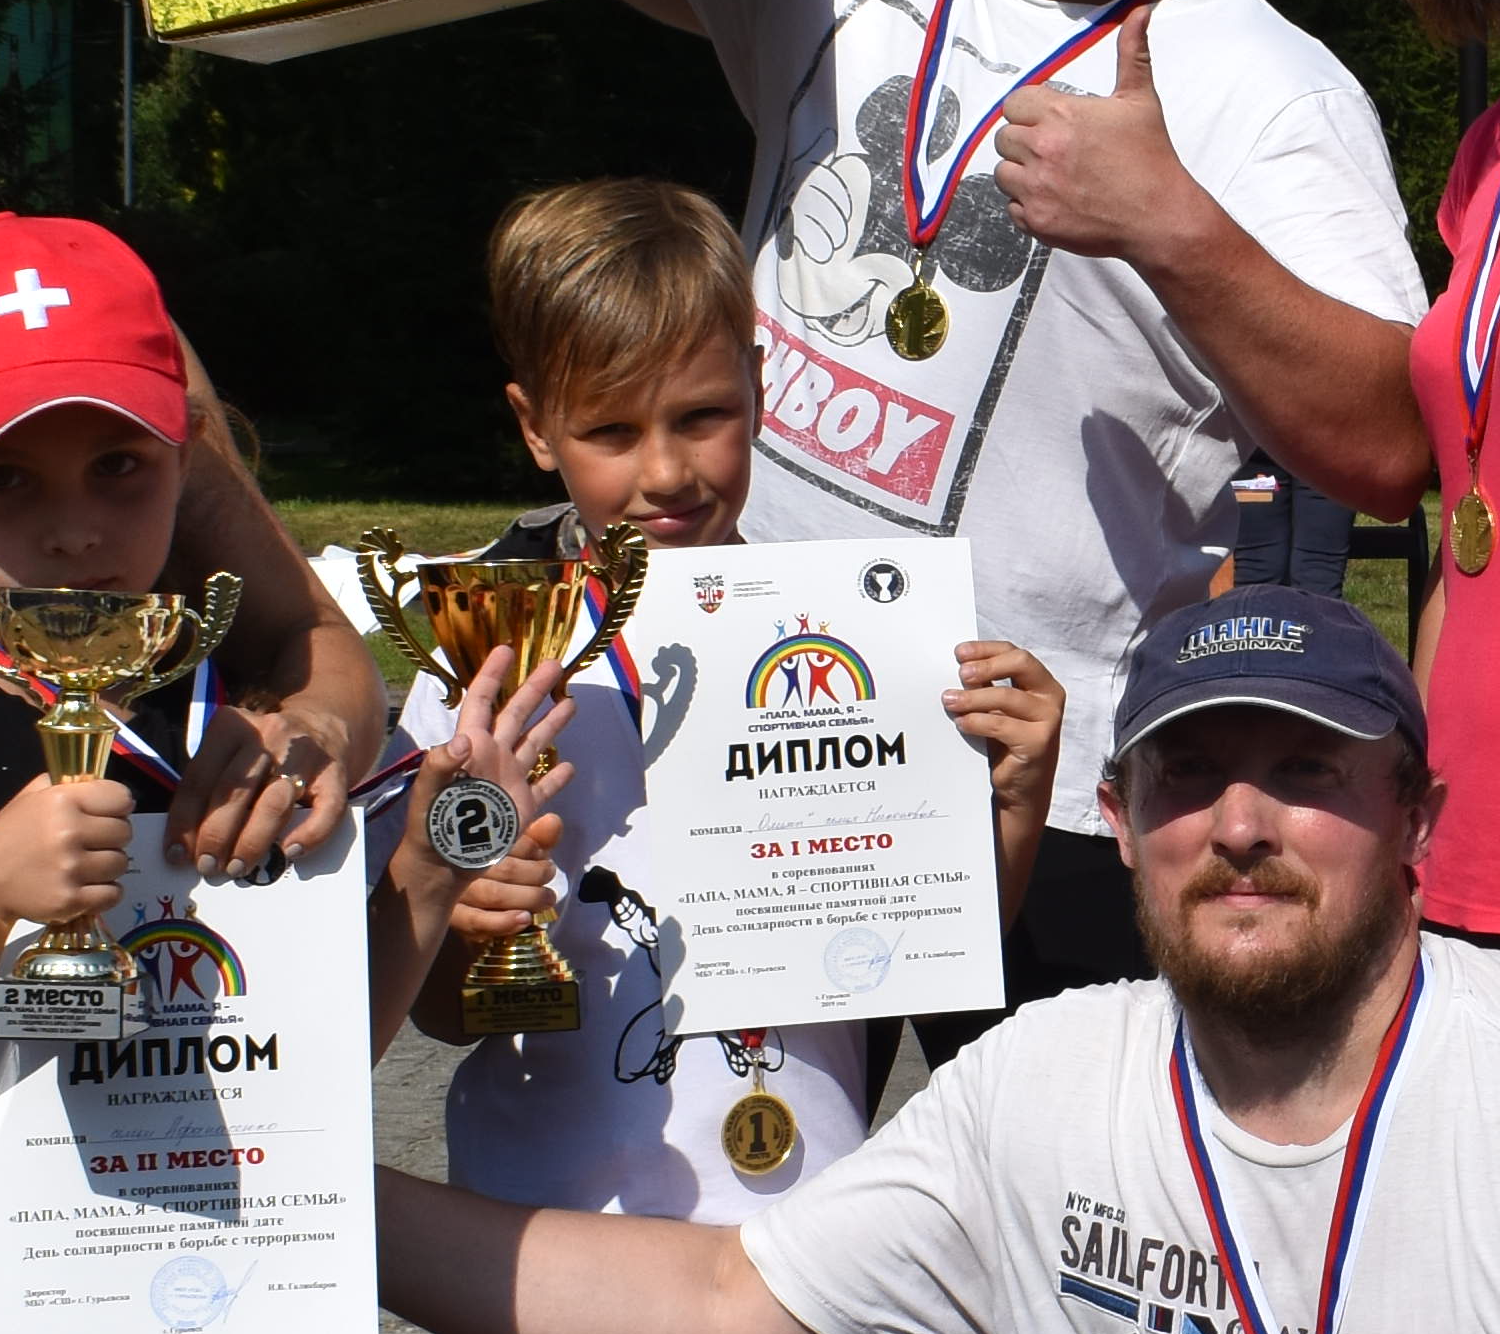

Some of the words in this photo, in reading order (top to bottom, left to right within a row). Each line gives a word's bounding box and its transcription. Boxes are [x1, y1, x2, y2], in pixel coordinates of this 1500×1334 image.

[1180, 617, 1305, 652] MAHLE
[1176, 639, 1304, 664] ORIGINAL
[804, 706, 844, 717] МАМА,
[847, 706, 854, 714] Я
[748, 720, 826, 733] СПОРТИВНАЯ
[725, 731, 906, 782] ДИПЛОМ
[759, 781, 876, 800] НАГРАЖДАЕТСЯ
[456, 798, 490, 846] 2
[690, 825, 742, 837] команда
[751, 841, 784, 859] ЗА
[808, 833, 893, 855] МЕСТО
[771, 870, 778, 879] в
[782, 863, 876, 880] соревнованиях
[678, 891, 731, 904] «ПАПА,
[733, 887, 783, 900] МАМА,
[786, 885, 796, 895] Я
[810, 876, 910, 894] СПОРТИВНАЯ
[913, 871, 970, 885] СЕМЬЯ»
[736, 901, 822, 917] посвященные
[826, 896, 887, 910] памятной
[890, 894, 917, 907] дате
[692, 924, 724, 937] День
[726, 917, 812, 933] солидарности
[816, 917, 823, 925] в
[827, 911, 868, 925] борьбе
[872, 913, 878, 921] с
[882, 905, 962, 922] терроризмом
[5, 988, 19, 1005] 2
[69, 1033, 279, 1086] ДИПЛОМ
[108, 1088, 242, 1106] НАГРАЖДАЕТСЯ
[25, 1135, 87, 1147] команда
[749, 1112, 766, 1152] 1
[90, 1155, 129, 1174] ЗА
[166, 1147, 265, 1169] МЕСТО
[118, 1187, 126, 1196] в
[130, 1180, 239, 1198] соревнованиях
[8, 1210, 70, 1224] «ПАПА,
[73, 1206, 131, 1220] МАМА,
[135, 1204, 146, 1215] Я
[163, 1195, 276, 1214] СПОРТИВНАЯ
[281, 1193, 346, 1207] СЕМЬЯ»
[1066, 1191, 1091, 1213] NYC
[75, 1223, 175, 1239] посвященные
[179, 1217, 249, 1233] памятной
[253, 1215, 284, 1228] дате
[22, 1246, 60, 1260] День
[64, 1240, 163, 1257] солидарности
[167, 1240, 175, 1250] в
[179, 1235, 228, 1251] борьбе
[232, 1237, 239, 1245] с
[243, 1231, 335, 1247] терроризмом
[1060, 1215, 1259, 1310] SAILFORT
